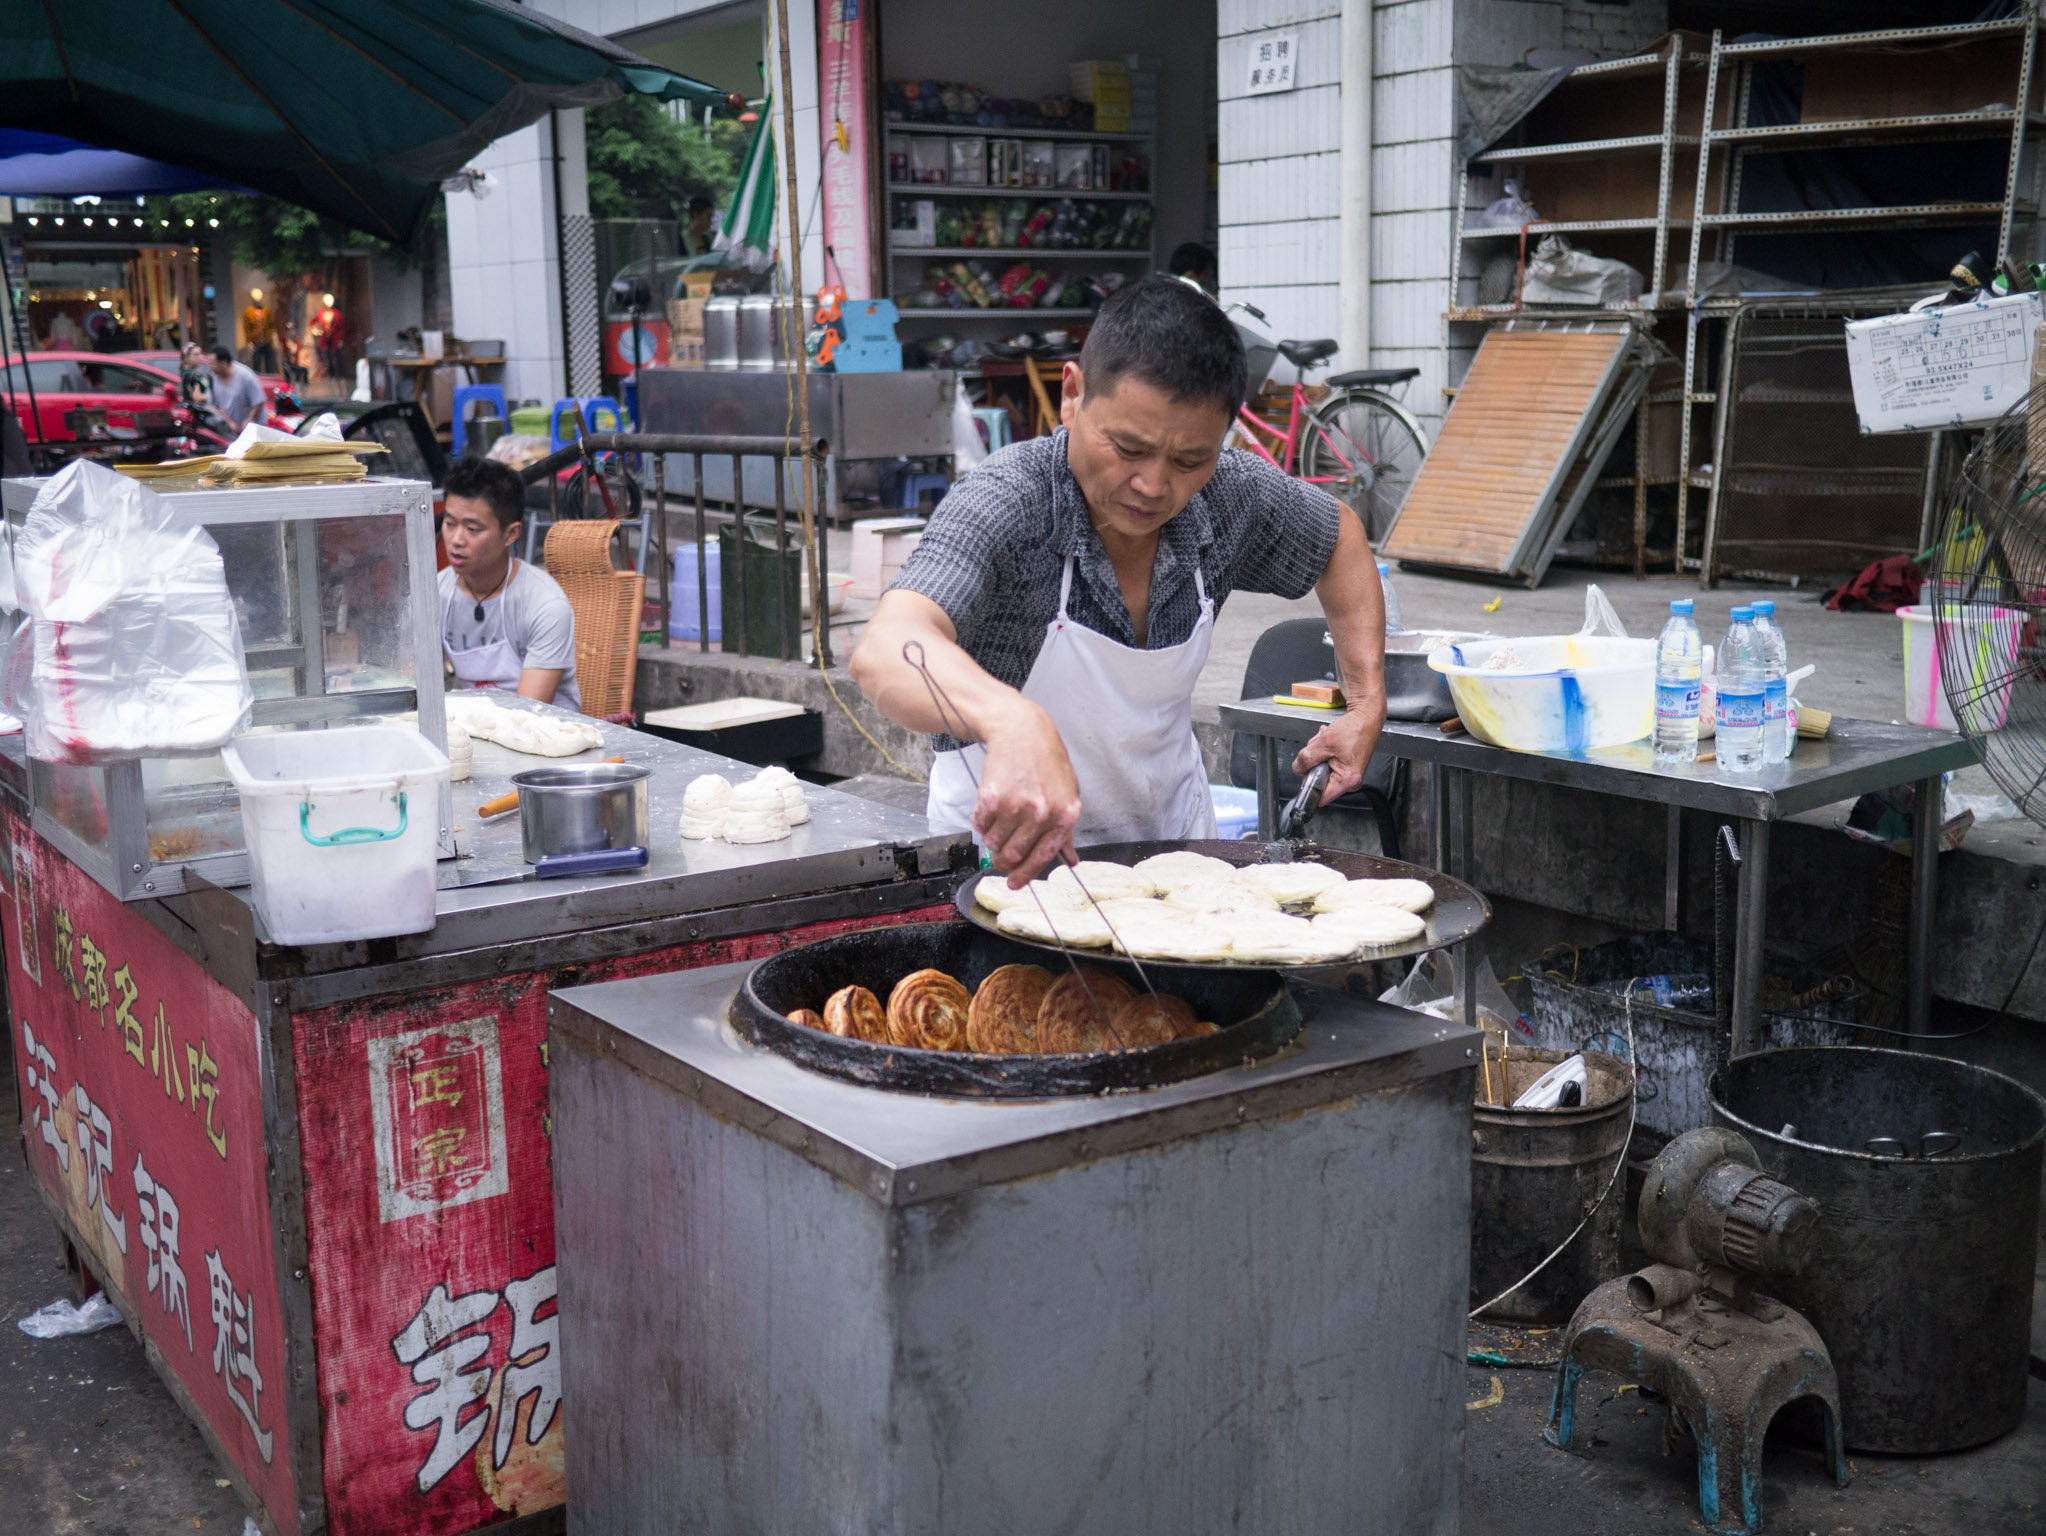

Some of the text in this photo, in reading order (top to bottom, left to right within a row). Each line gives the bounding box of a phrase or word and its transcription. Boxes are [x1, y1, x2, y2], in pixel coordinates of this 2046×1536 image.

[1259, 41, 1288, 62] 招聘
[54, 899, 227, 1161] 成都名小吃
[411, 1065, 468, 1173] 正宗
[23, 1019, 273, 1466] 汪记锅魁
